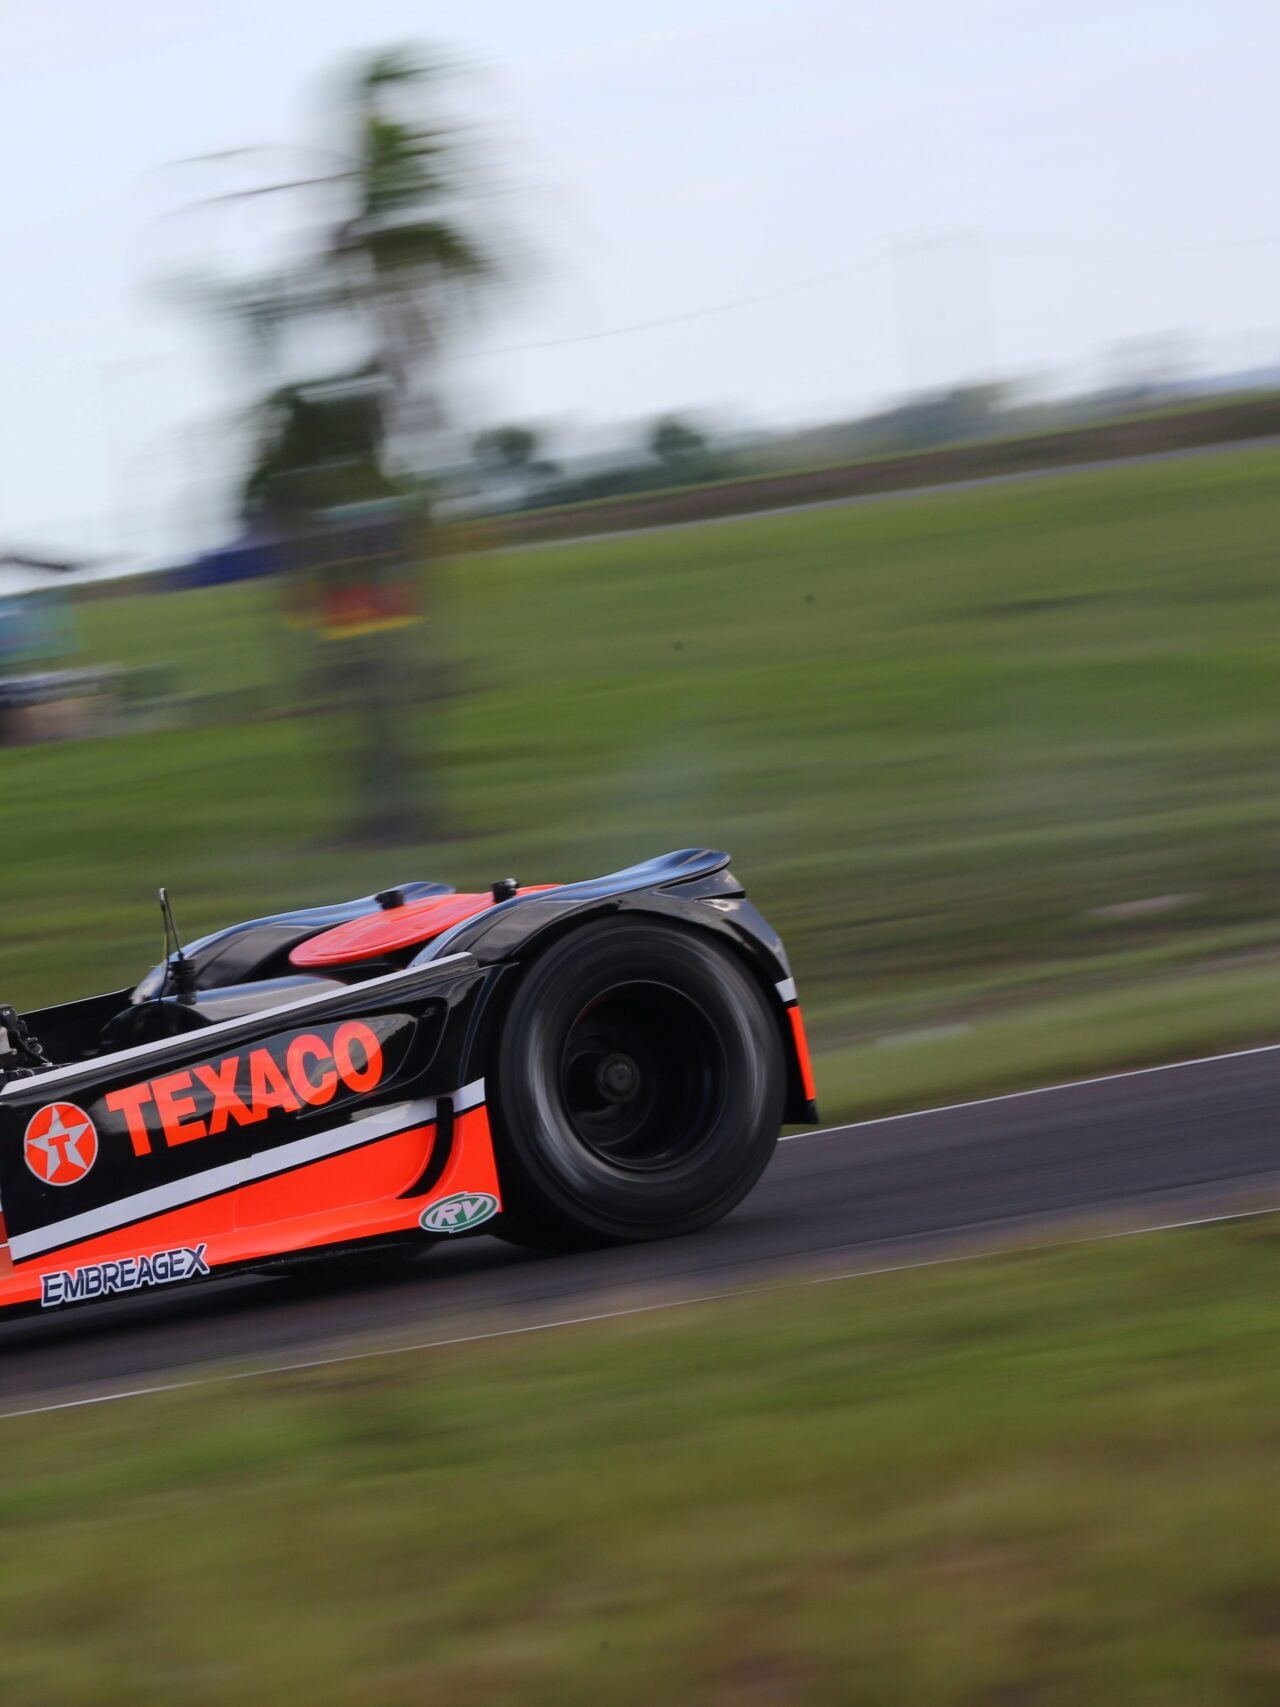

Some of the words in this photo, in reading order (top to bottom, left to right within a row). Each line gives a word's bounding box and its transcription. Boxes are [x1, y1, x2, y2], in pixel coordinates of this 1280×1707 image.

[104, 1021, 383, 1157] TEXACO
[434, 1197, 489, 1226] RV
[40, 1243, 210, 1305] EMBREAGEX
